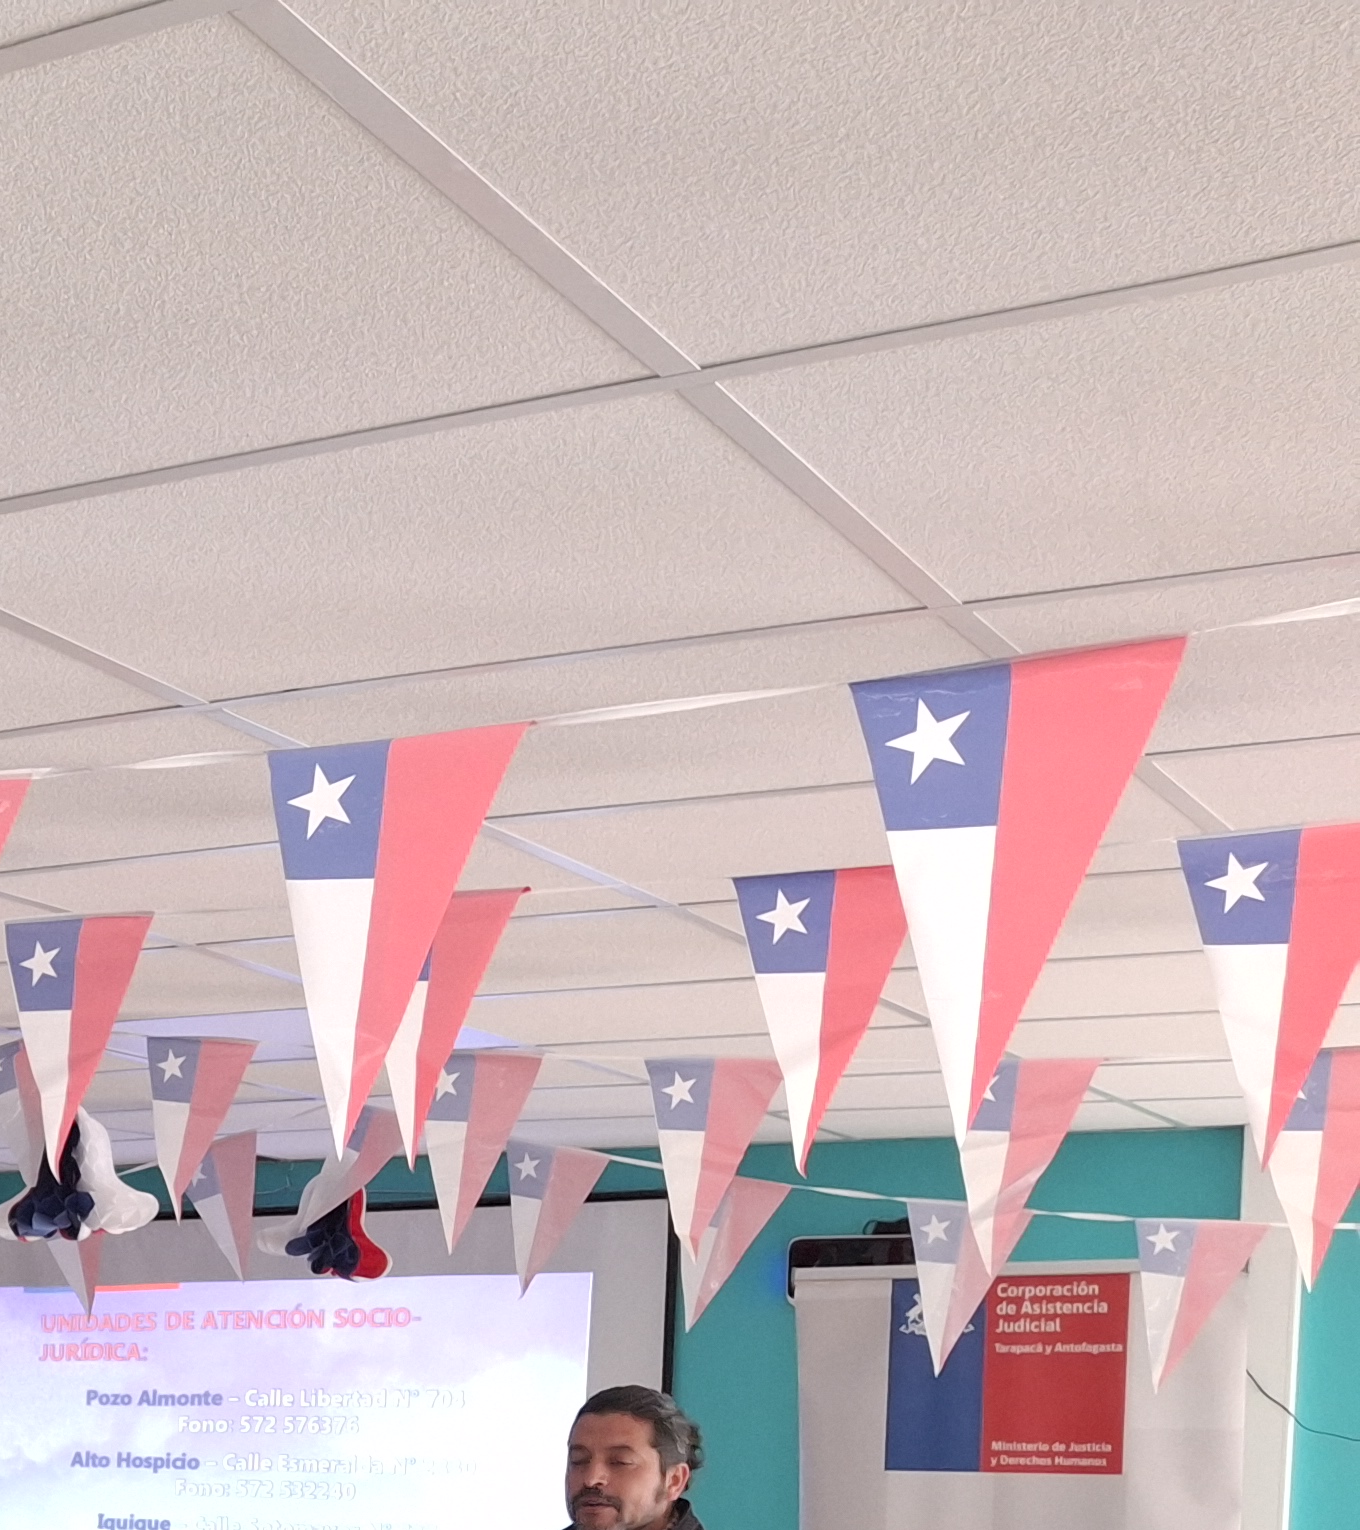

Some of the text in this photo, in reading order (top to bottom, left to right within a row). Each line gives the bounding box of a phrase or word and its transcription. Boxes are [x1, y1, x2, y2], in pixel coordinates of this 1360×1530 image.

[996, 1280, 1100, 1300] Corporación
[996, 1299, 1108, 1315] de Asistencia
[40, 1303, 422, 1333] UNIDADES DE ATENCIÓN SOCIO-
[995, 1317, 1061, 1333] Judicial
[38, 1337, 148, 1362] JURÍDICA:
[994, 1342, 1043, 1355] Tarapacá
[1045, 1344, 1053, 1355] y
[86, 1389, 132, 1406] Pozo
[137, 1389, 223, 1407] Almonte
[244, 1387, 295, 1409] Calle
[300, 1387, 387, 1409] Libertad
[178, 1415, 360, 1435] Fono: 572 576376
[991, 1440, 1112, 1453] Ministerio de Justicia
[70, 1451, 111, 1468] Alto
[117, 1452, 200, 1473] Hospicio
[222, 1452, 273, 1472] Calle
[990, 1456, 998, 1467] y
[174, 1478, 357, 1500] Fono: 572 532240
